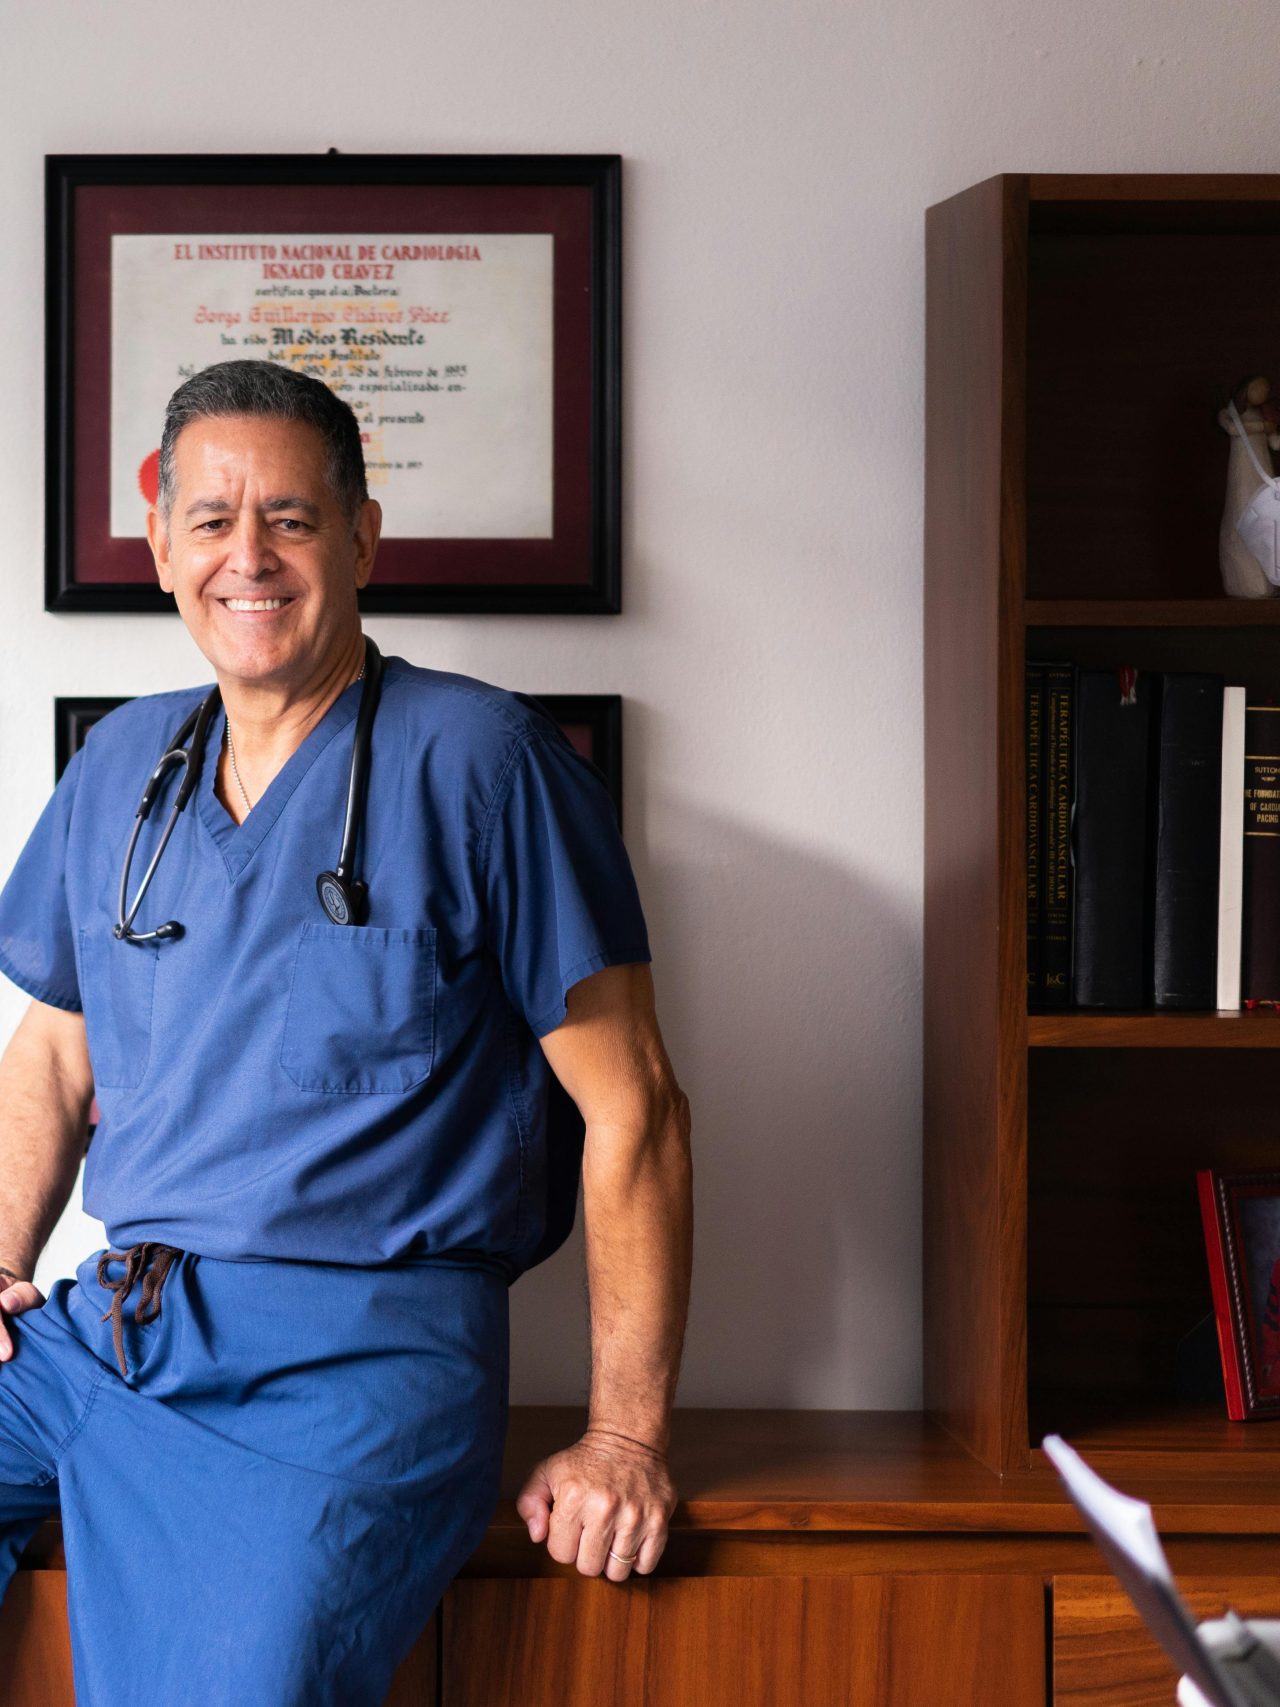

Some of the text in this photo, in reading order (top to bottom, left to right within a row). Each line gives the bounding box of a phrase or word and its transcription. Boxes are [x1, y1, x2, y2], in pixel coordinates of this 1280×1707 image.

[174, 244, 482, 262] EL INSTITUTO NACIONAL DE CARDIOLOGIA
[262, 263, 396, 280] IGNACIO CHAVEZ
[307, 288, 326, 300] que
[1257, 813, 1279, 823] PACING
[1058, 783, 1069, 900] CARDIOVASCULAR
